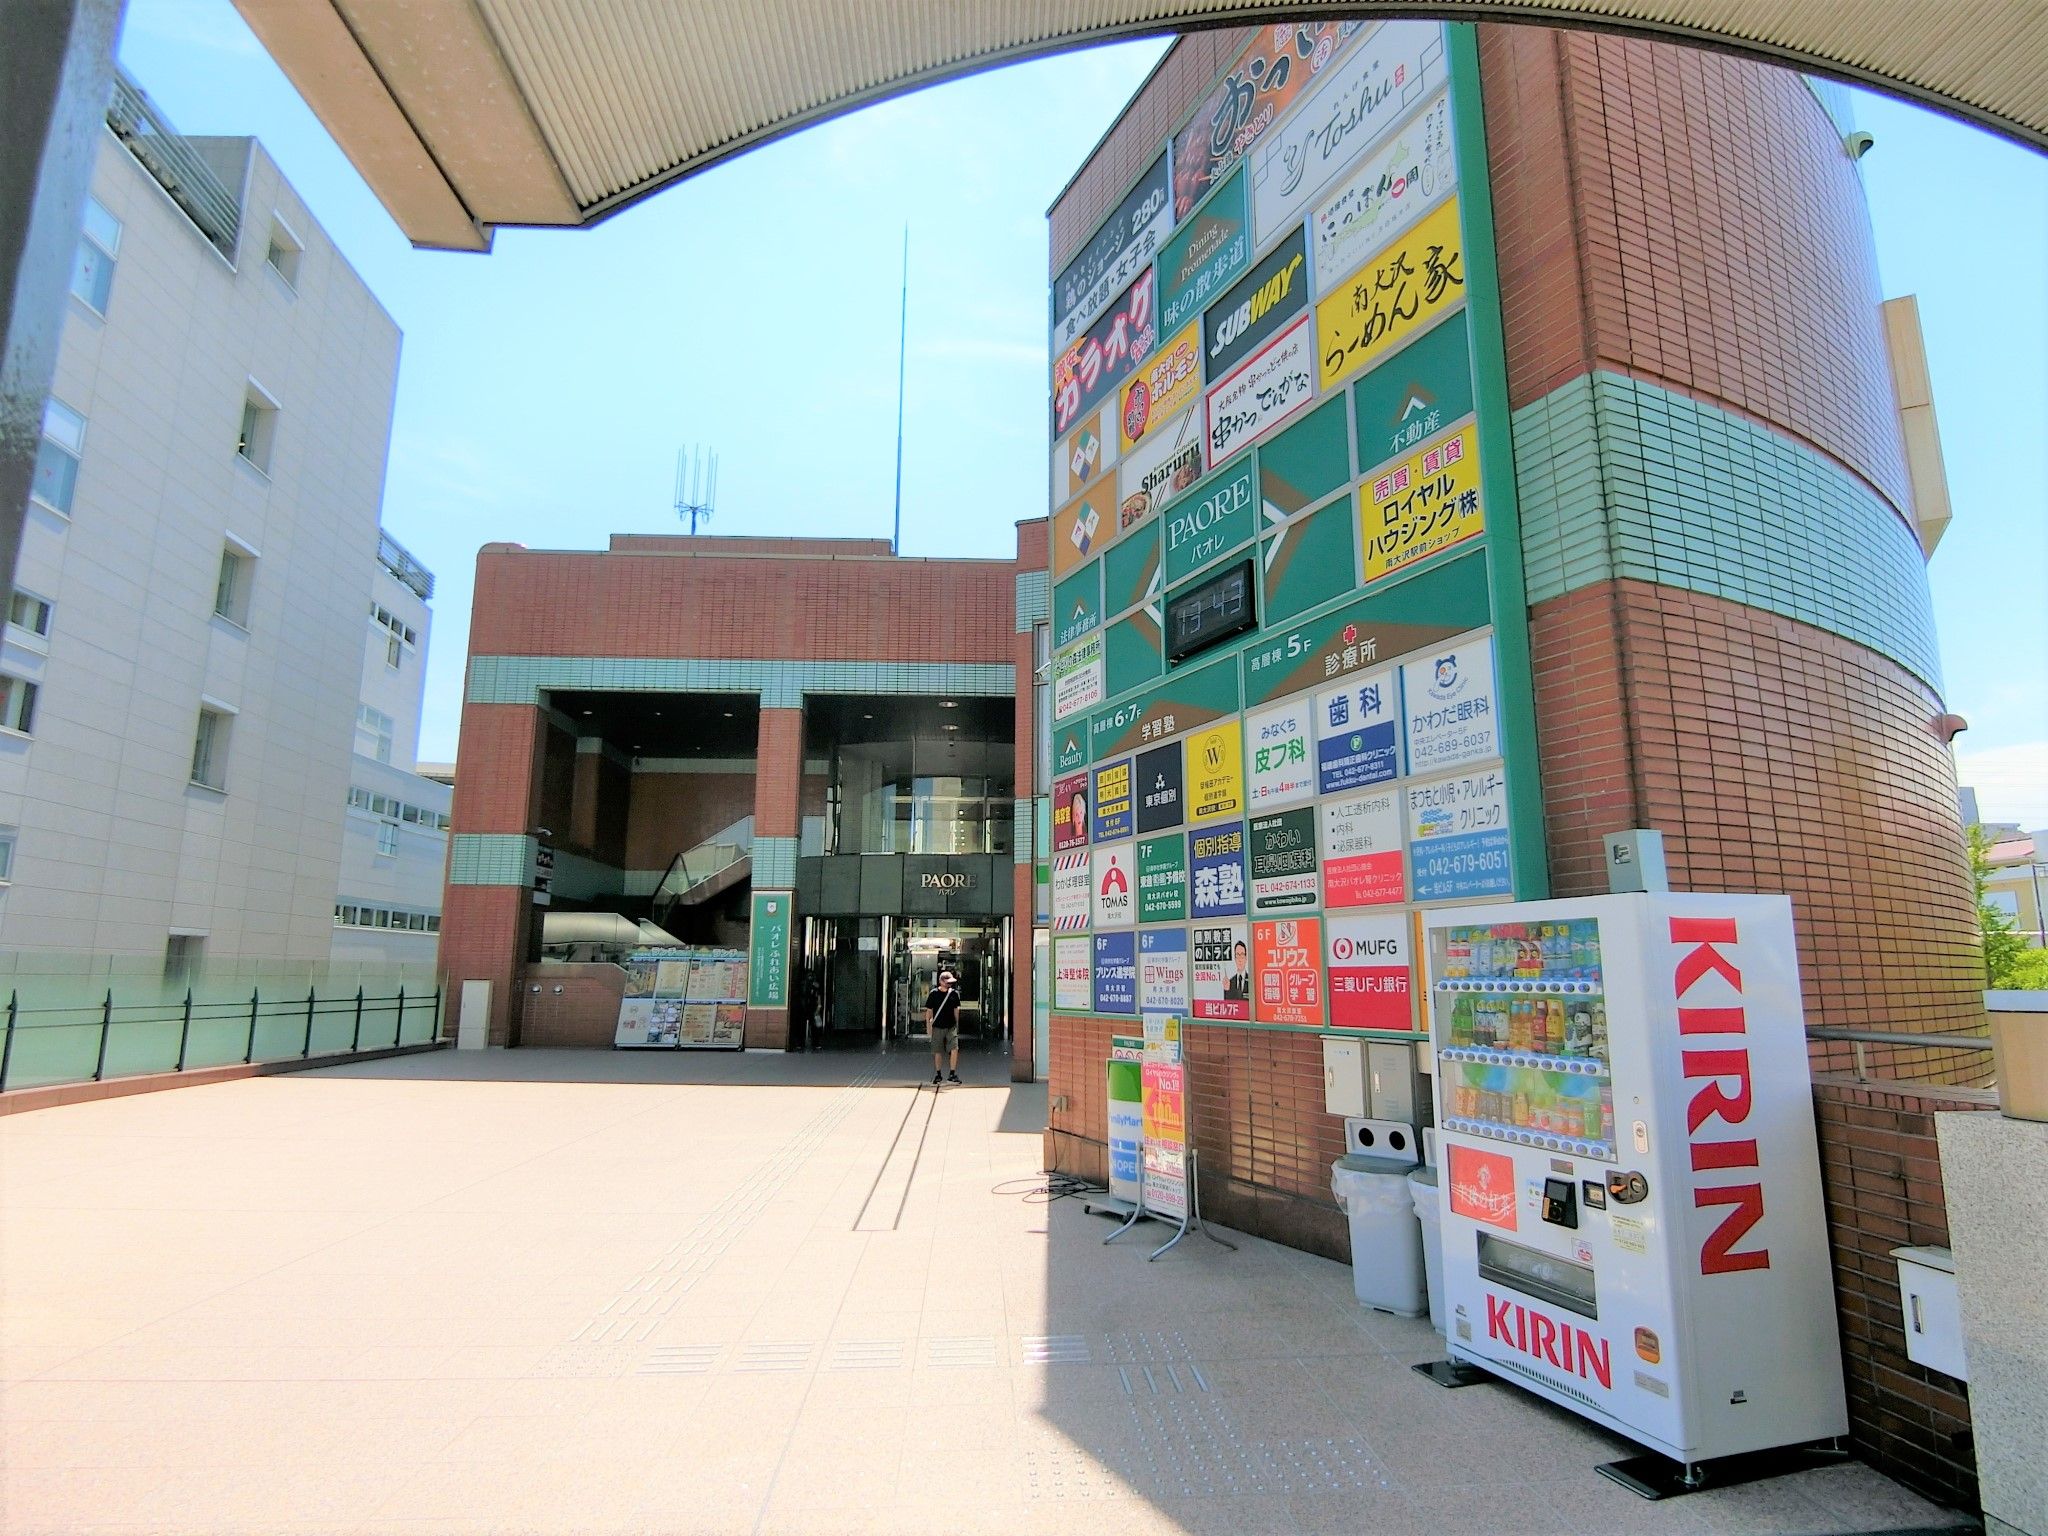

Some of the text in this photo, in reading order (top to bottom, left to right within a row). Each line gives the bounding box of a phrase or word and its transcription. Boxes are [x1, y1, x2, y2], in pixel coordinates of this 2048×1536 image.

[1233, 102, 1275, 155] やきとり
[1314, 78, 1392, 161] Toshu
[1187, 223, 1219, 259] Dining
[1180, 228, 1230, 283] Promenade
[1065, 229, 1157, 342] 食べ放題・女子会
[1163, 234, 1245, 328] 味の散歩道
[1350, 250, 1416, 318] 南大沢
[1209, 252, 1304, 360] SUBWAY
[1054, 266, 1154, 434] カラオケ
[1151, 350, 1200, 404] ホルモン
[1389, 409, 1441, 454] 不動産
[1141, 441, 1201, 495] Sharuru
[1374, 437, 1463, 503] 売買・賃貸
[1168, 473, 1251, 551] PAORE
[1383, 474, 1455, 526] ロイヤル
[1190, 533, 1225, 564] パオレ
[1384, 526, 1461, 570] 南大沢駅前ショップ
[1060, 611, 1097, 646] 法律事務所
[1250, 647, 1283, 673] 高層棟
[1324, 636, 1377, 677] 診療所
[1327, 682, 1383, 728] 歯科
[1412, 695, 1490, 735] かわだ眼科
[1141, 714, 1176, 741] 学習塾
[1206, 744, 1222, 767] W
[1254, 735, 1306, 775] 皮フ科
[1414, 730, 1491, 759] 042-689-6037
[1059, 750, 1083, 769] Beauty
[1145, 788, 1177, 808] 東京個別
[1410, 773, 1504, 810] まつもと小児・アレルギー
[1336, 797, 1391, 819] 人工透析内科
[1459, 804, 1501, 830] クリニック
[1264, 828, 1302, 851] かわい
[1336, 821, 1354, 836] 内科
[1140, 844, 1153, 859] 7F
[1194, 831, 1242, 860] 個別指導
[1337, 835, 1373, 853] 泌尿器科
[1254, 846, 1315, 874] 耳鼻咽喉科
[1428, 849, 1509, 877] 042-679-6051
[921, 872, 977, 889] PAORE
[1255, 884, 1270, 894] TEL
[1101, 895, 1129, 909] TOMAS
[1096, 937, 1108, 951] 6F
[1141, 934, 1155, 950] 6F
[1195, 929, 1232, 945] 個別教室
[1257, 928, 1272, 941] 6F
[1356, 939, 1398, 956] MUFG
[767, 925, 782, 1000] パオレふれあい広場
[1195, 945, 1232, 961] のトライ
[1266, 948, 1310, 968] ユリウス
[1056, 967, 1090, 981] 上海整体院
[1095, 965, 1136, 980] プリンス進学院
[1155, 966, 1185, 982] Wings
[1288, 973, 1315, 986] グループ
[1333, 976, 1408, 993] 三菱UFJ銀行
[1205, 1002, 1240, 1017] 当ビル7F
[1669, 915, 1771, 1276] KIRIN
[1486, 1292, 1613, 1391] KIRIN
